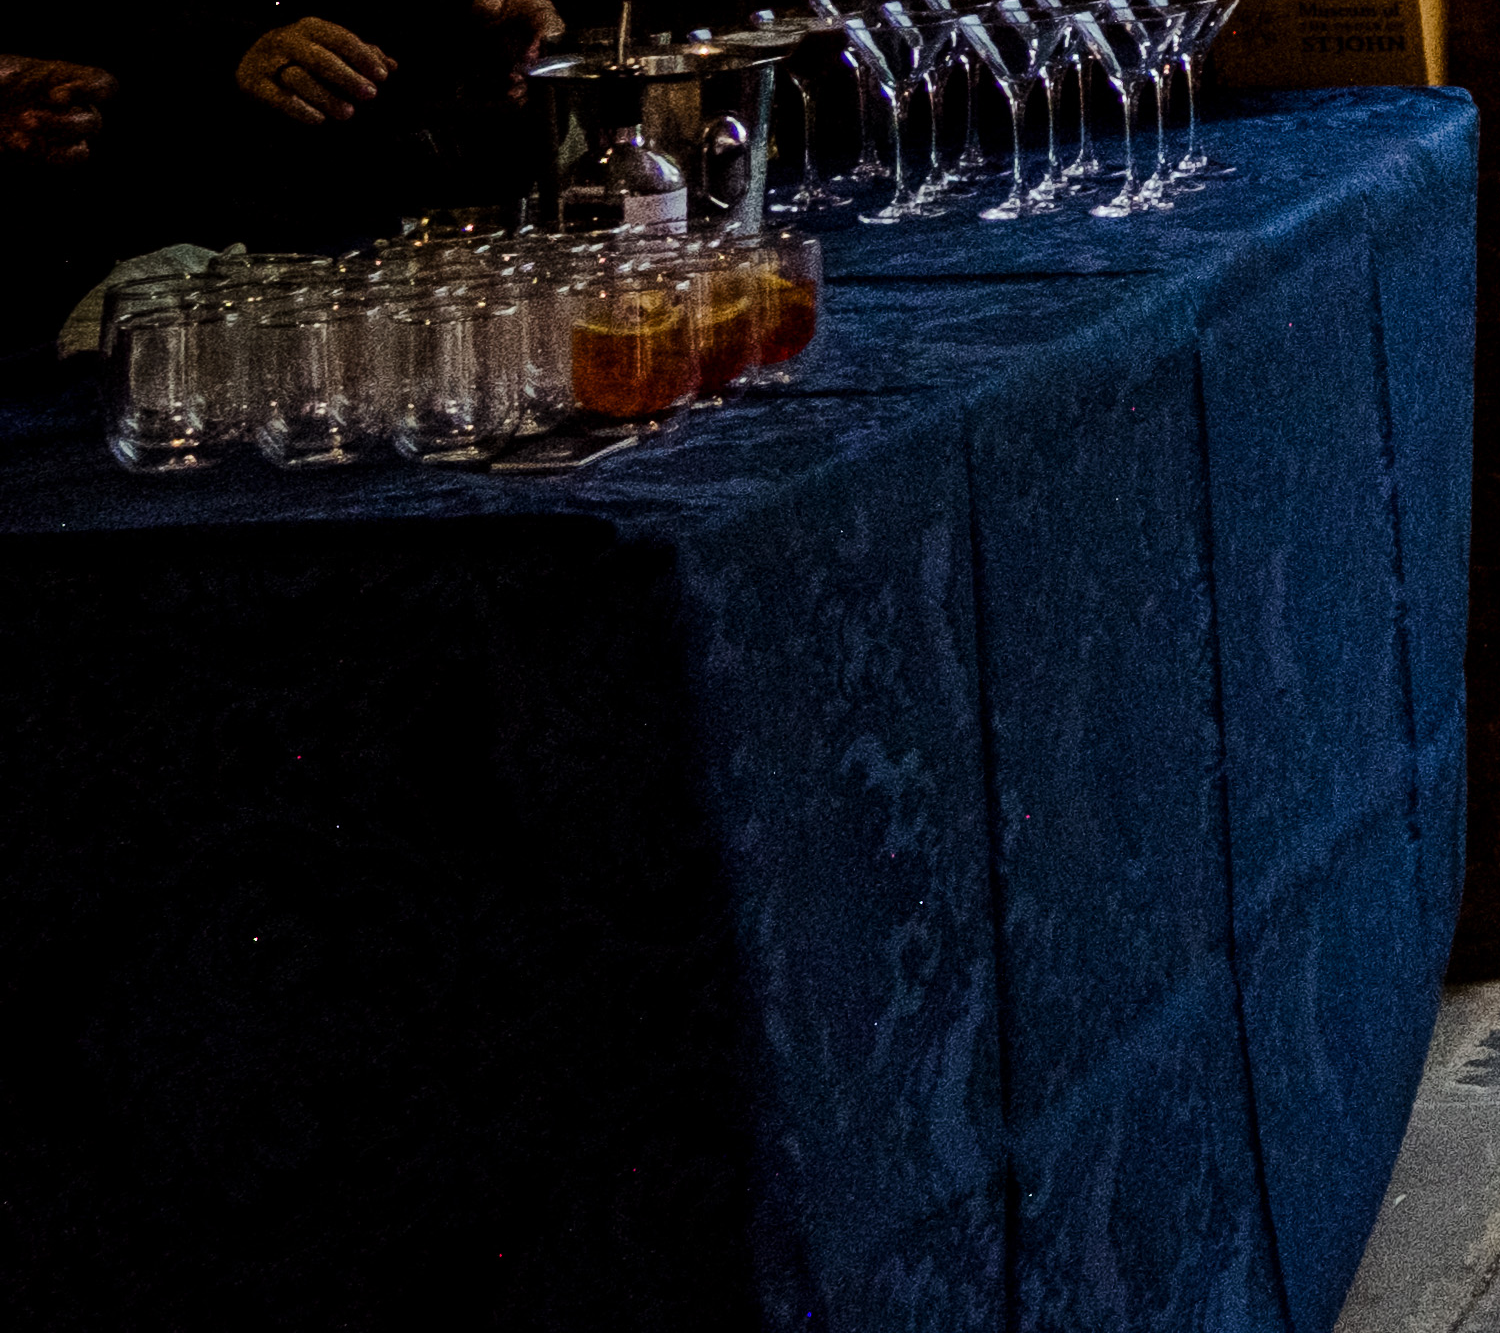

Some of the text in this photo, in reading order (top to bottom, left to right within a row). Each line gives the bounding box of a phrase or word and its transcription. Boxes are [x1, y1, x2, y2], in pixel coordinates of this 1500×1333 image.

[1298, 1, 1378, 18] Museum
[1302, 35, 1407, 54] ST JOHN
